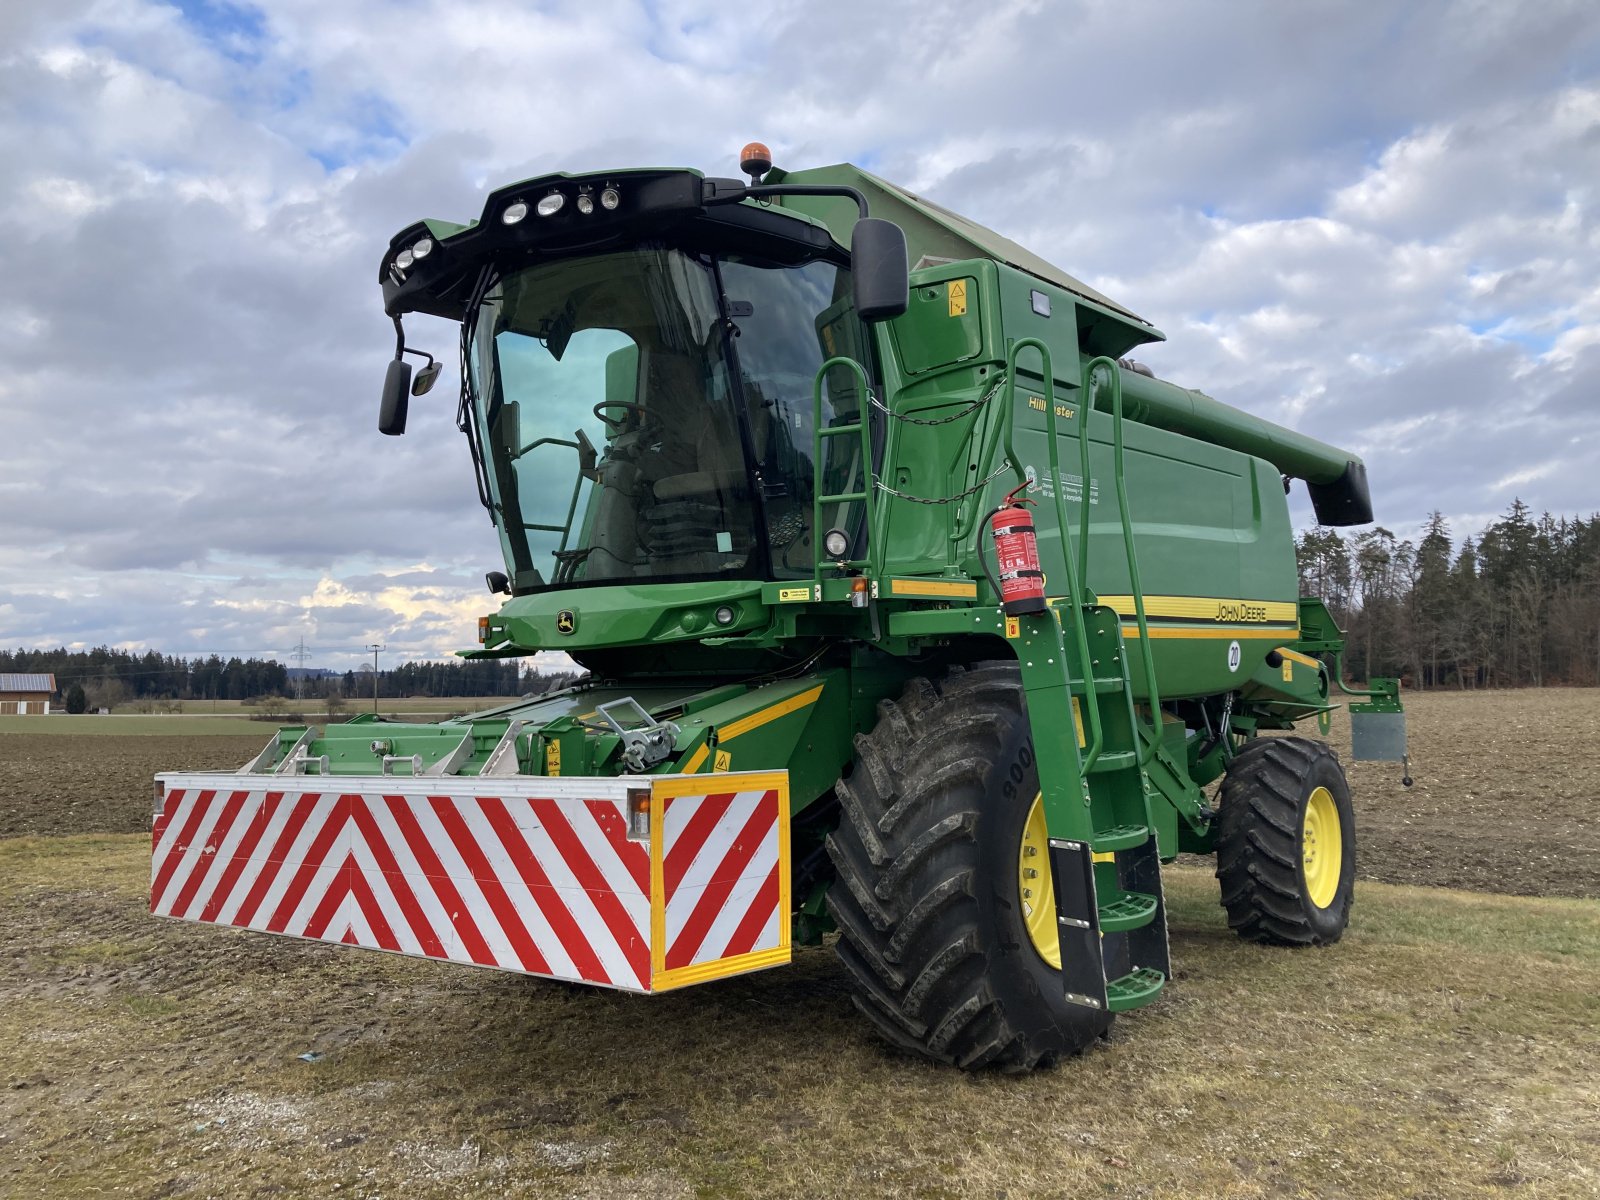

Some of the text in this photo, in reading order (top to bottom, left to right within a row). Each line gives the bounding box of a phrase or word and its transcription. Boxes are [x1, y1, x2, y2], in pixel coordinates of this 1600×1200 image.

[1029, 396, 1075, 419] Hillster
[1215, 603, 1266, 620] JOHN DEERE
[1230, 646, 1239, 667] 20
